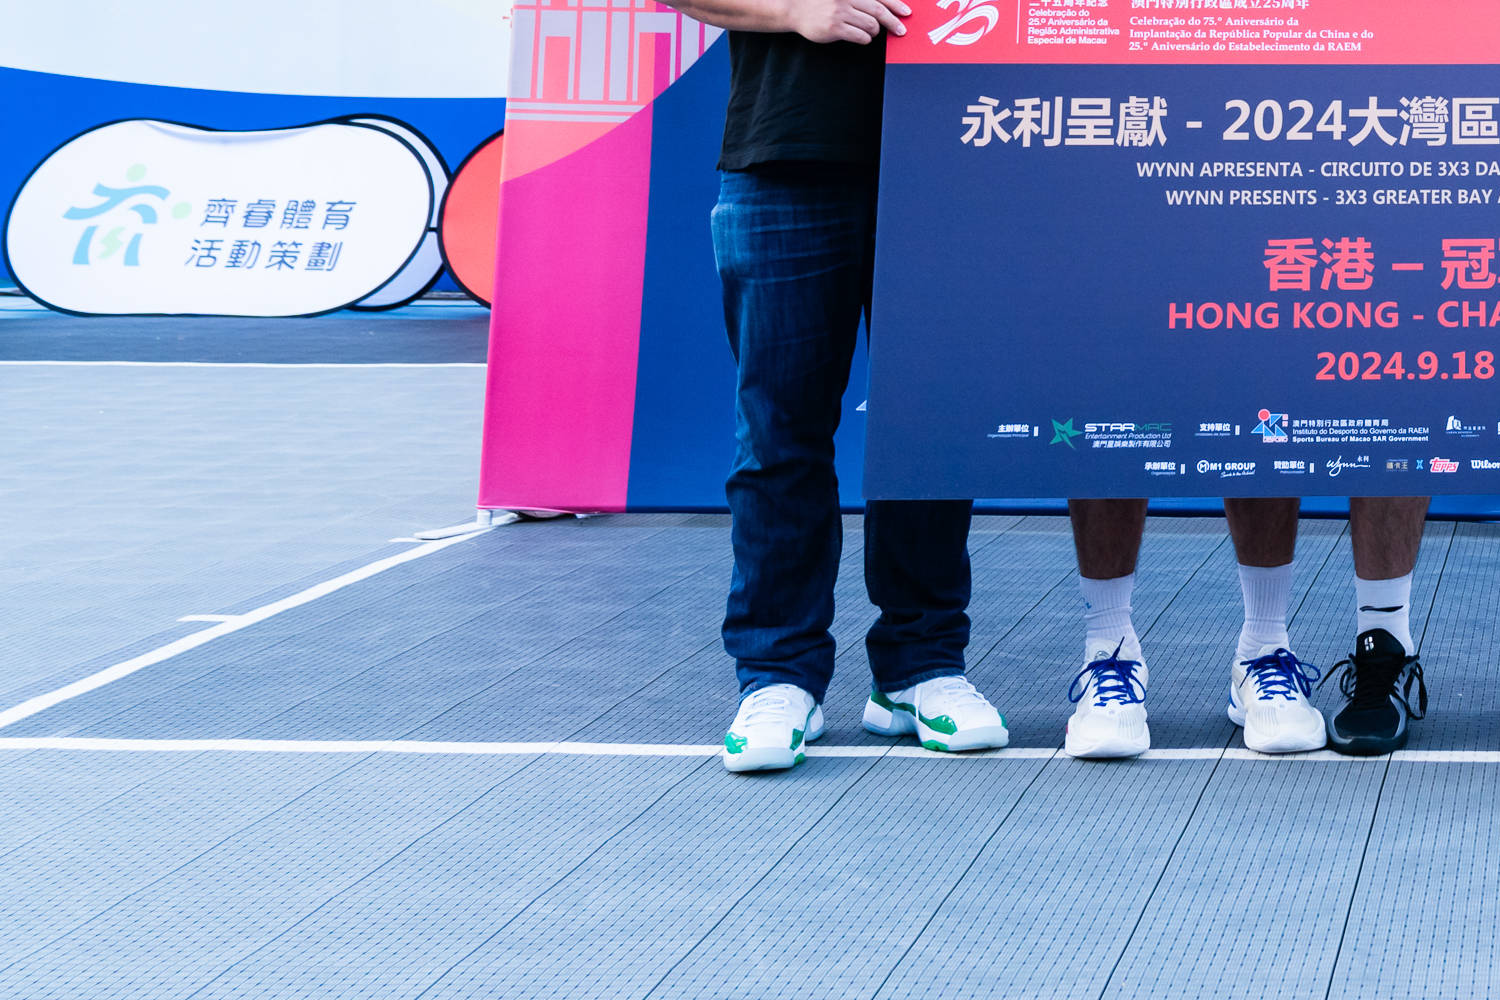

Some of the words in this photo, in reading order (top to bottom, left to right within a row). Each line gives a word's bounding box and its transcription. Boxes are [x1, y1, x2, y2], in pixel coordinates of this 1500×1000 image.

[1029, 8, 1077, 17] Celebração
[1048, 17, 1095, 25] Aniversário
[1130, 16, 1185, 27] Celebração
[1203, 17, 1222, 25] 75.º
[1225, 17, 1284, 25] Aniversário
[1028, 26, 1057, 37] Região
[1059, 26, 1119, 35] Administrativa
[1130, 29, 1191, 41] Implantação
[1210, 29, 1260, 41] República
[1263, 29, 1302, 41] Popular
[1320, 30, 1349, 39] China
[1028, 36, 1064, 46] Especial
[1079, 36, 1107, 44] Macau
[1129, 42, 1148, 51] 25.º
[1152, 42, 1210, 51] Aniversário
[1229, 42, 1310, 51] Estabelecimento
[1328, 42, 1361, 51] RAEM
[961, 96, 1167, 147] 永利呈獻
[1137, 162, 1193, 177] WYNN
[1200, 162, 1302, 177] APRESENTA
[1321, 162, 1404, 177] CIRCUITO
[1410, 161, 1432, 176] DE
[1438, 161, 1469, 176] 3X3
[1476, 161, 1500, 176] DA
[1166, 190, 1223, 205] WYNN
[1230, 190, 1316, 205] PRESENTS
[1336, 190, 1367, 205] 3X3
[1373, 189, 1452, 205] GREATER
[1458, 189, 1492, 204] BAY
[199, 198, 357, 231] 齊睿體育
[185, 239, 345, 272] 活動策劃
[1263, 237, 1374, 291] 香港
[1169, 301, 1279, 329] HONG
[1294, 301, 1398, 329] KONG
[1316, 351, 1494, 380] 2024.9.18
